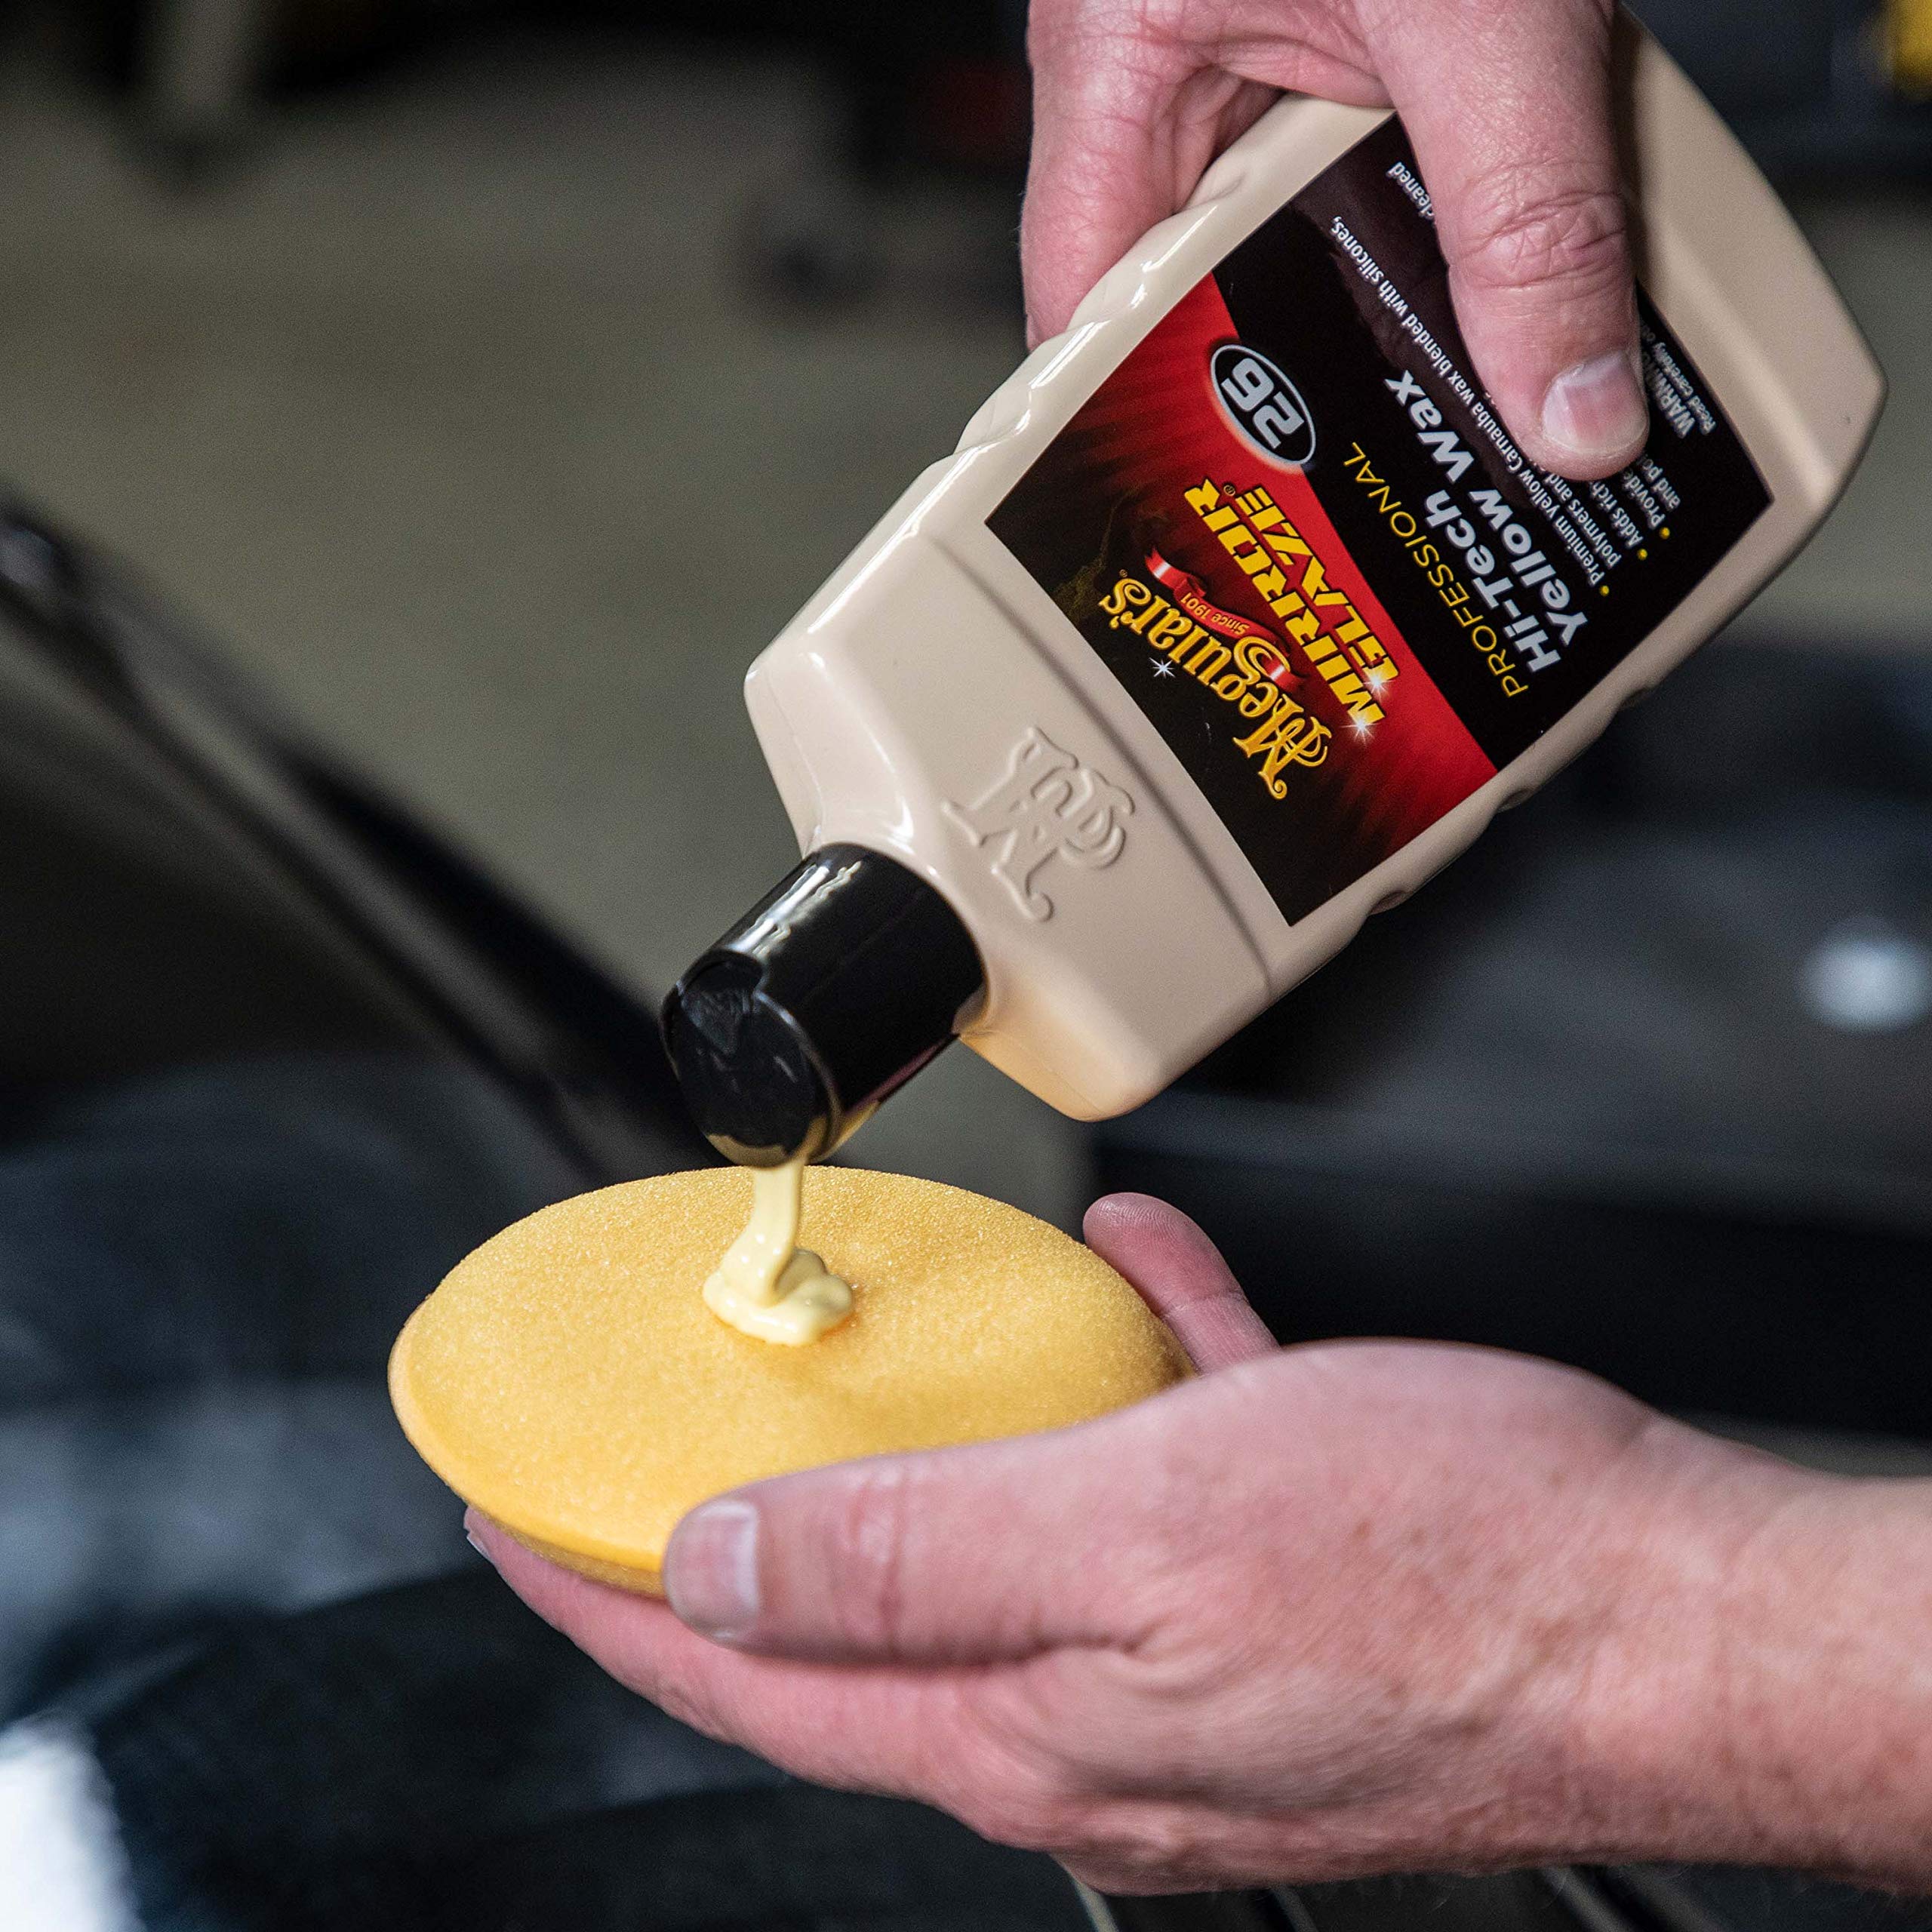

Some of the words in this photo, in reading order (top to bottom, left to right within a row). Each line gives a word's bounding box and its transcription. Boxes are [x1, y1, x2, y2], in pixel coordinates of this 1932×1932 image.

[1331, 216, 1383, 284] silicones,
[1378, 279, 1407, 317] with
[1401, 312, 1452, 377] blended
[1221, 358, 1303, 448] 26
[1447, 370, 1474, 405] wax
[1687, 395, 1715, 433] Read
[1384, 370, 1474, 481] Wax
[1471, 401, 1522, 472] Carnauba
[1518, 469, 1559, 518] yellow
[1544, 473, 1572, 500] and
[1589, 481, 1617, 510] rich
[1623, 470, 1664, 528] Provide
[1651, 477, 1680, 509] and
[1555, 515, 1604, 585] Premium
[1567, 499, 1621, 566] polymers
[1612, 507, 1643, 546] Adds
[1235, 488, 1398, 691] GLAZE
[1343, 441, 1528, 697] PROFESSIONAL
[1426, 490, 1560, 671] Hi-Tech
[1469, 489, 1587, 645] Yellow
[1180, 592, 1211, 619] 1901
[1184, 478, 1384, 731] MIRROR
[1211, 614, 1249, 635] Since
[1098, 574, 1331, 798] Meguiar's
